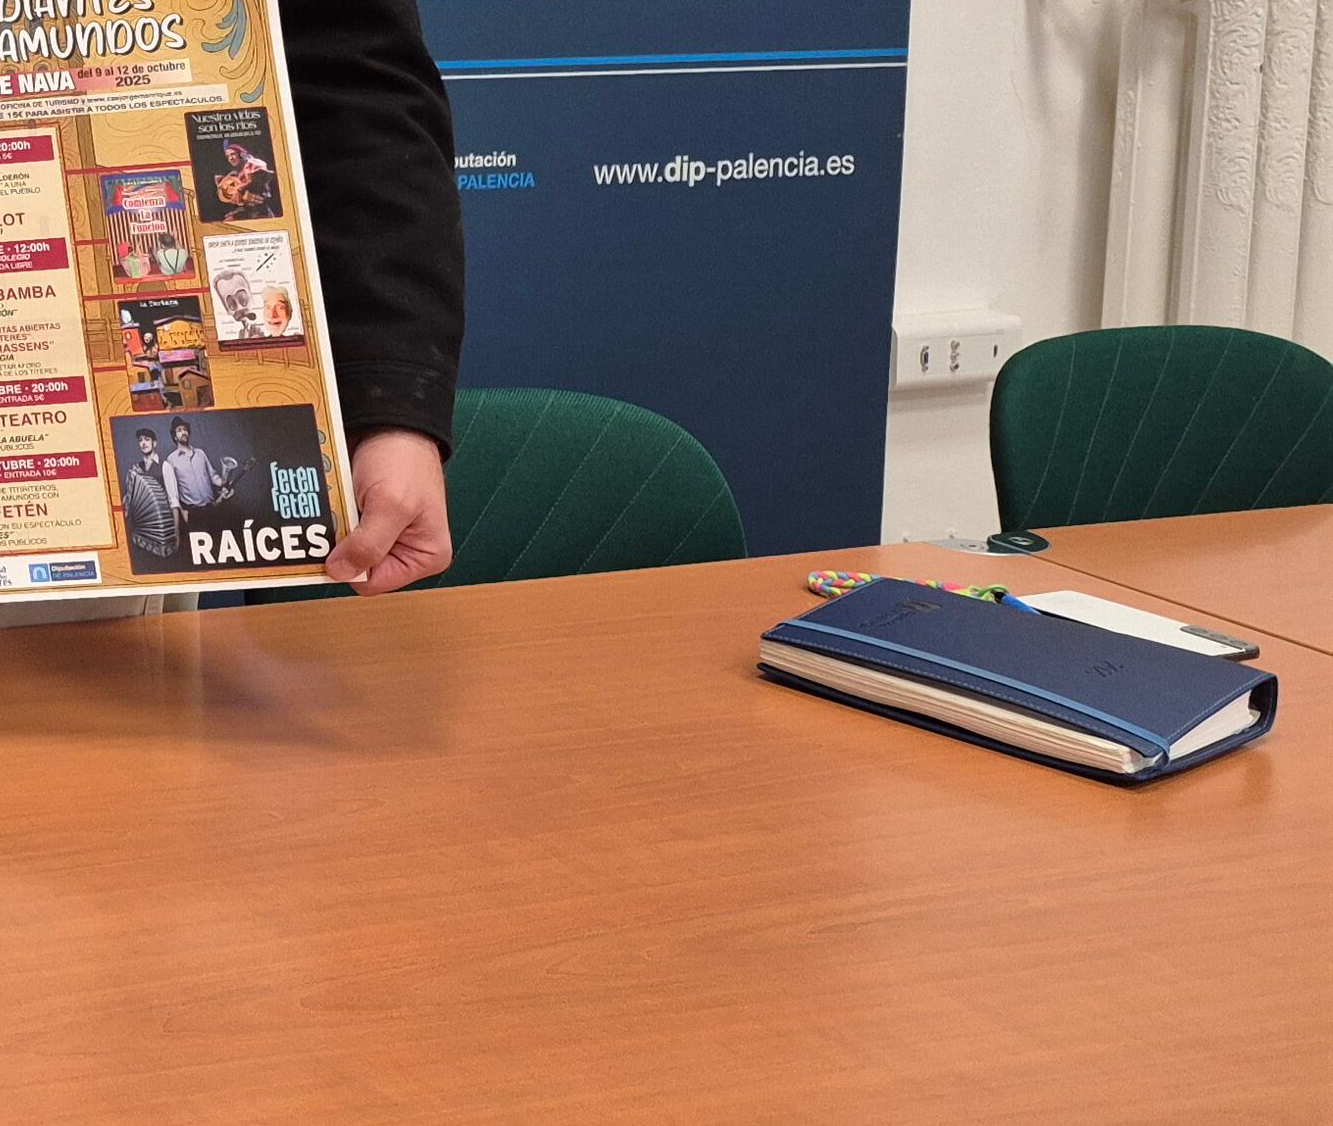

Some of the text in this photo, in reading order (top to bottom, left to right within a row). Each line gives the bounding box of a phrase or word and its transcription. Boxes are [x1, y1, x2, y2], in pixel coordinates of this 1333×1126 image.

[77, 60, 185, 78] del 9 al 12 de octubre
[17, 68, 75, 93] NAVA
[115, 74, 151, 87] 2025
[0, 101, 30, 110] OFICINA
[44, 98, 78, 107] TURISMO
[25, 109, 48, 118] PARA
[50, 106, 85, 115] ASISTIR
[96, 103, 127, 112] TODOS
[129, 101, 146, 109] LOS
[593, 151, 855, 188] www.dip-palencia.es
[457, 173, 535, 190] PALENCIA
[13, 241, 49, 253] 12:00h
[19, 322, 60, 331] ABIERTAS
[31, 380, 68, 392] 20:00h
[43, 455, 79, 467] 20:00h
[3, 469, 41, 479] ENTRADA
[24, 517, 81, 529] ESPECTÁCULO
[187, 514, 331, 565] RAÍCES
